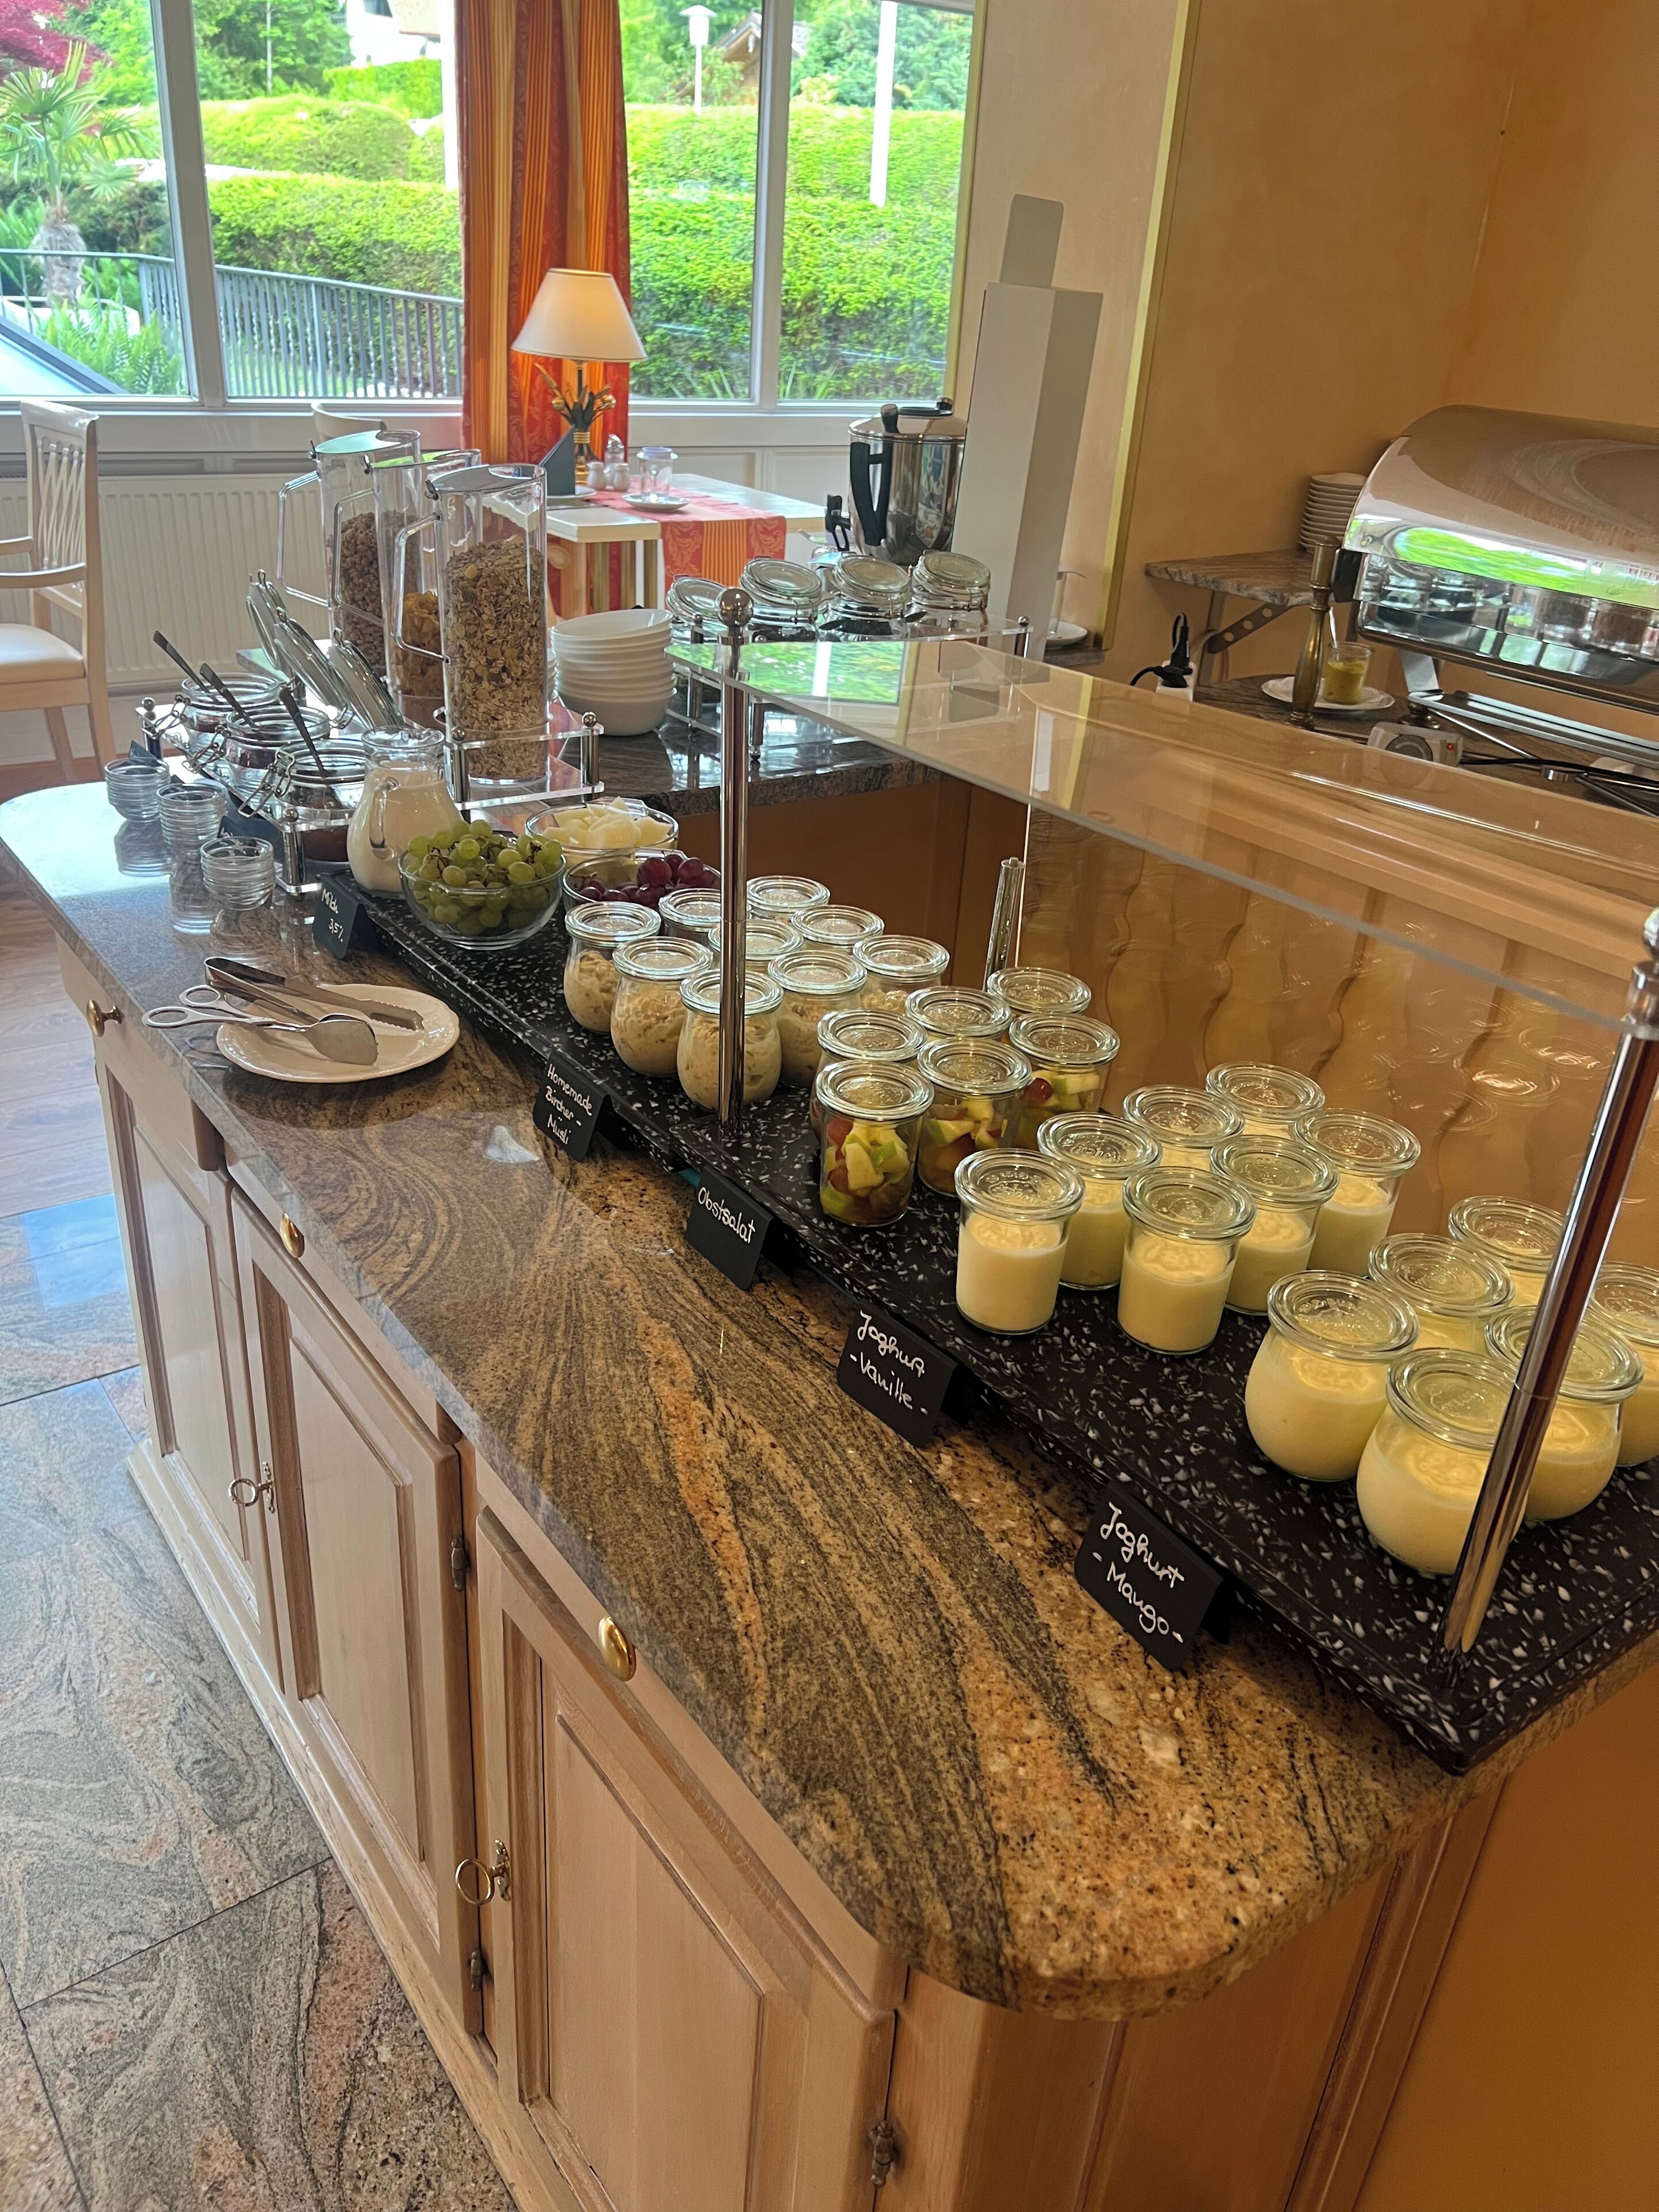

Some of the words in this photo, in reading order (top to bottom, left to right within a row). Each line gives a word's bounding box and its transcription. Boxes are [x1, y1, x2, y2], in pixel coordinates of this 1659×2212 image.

[547, 1063, 592, 1116] Homemade
[547, 1113, 571, 1145] Müsli
[698, 1186, 756, 1244] Obstsalat
[1100, 1501, 1185, 1589] Joghurt
